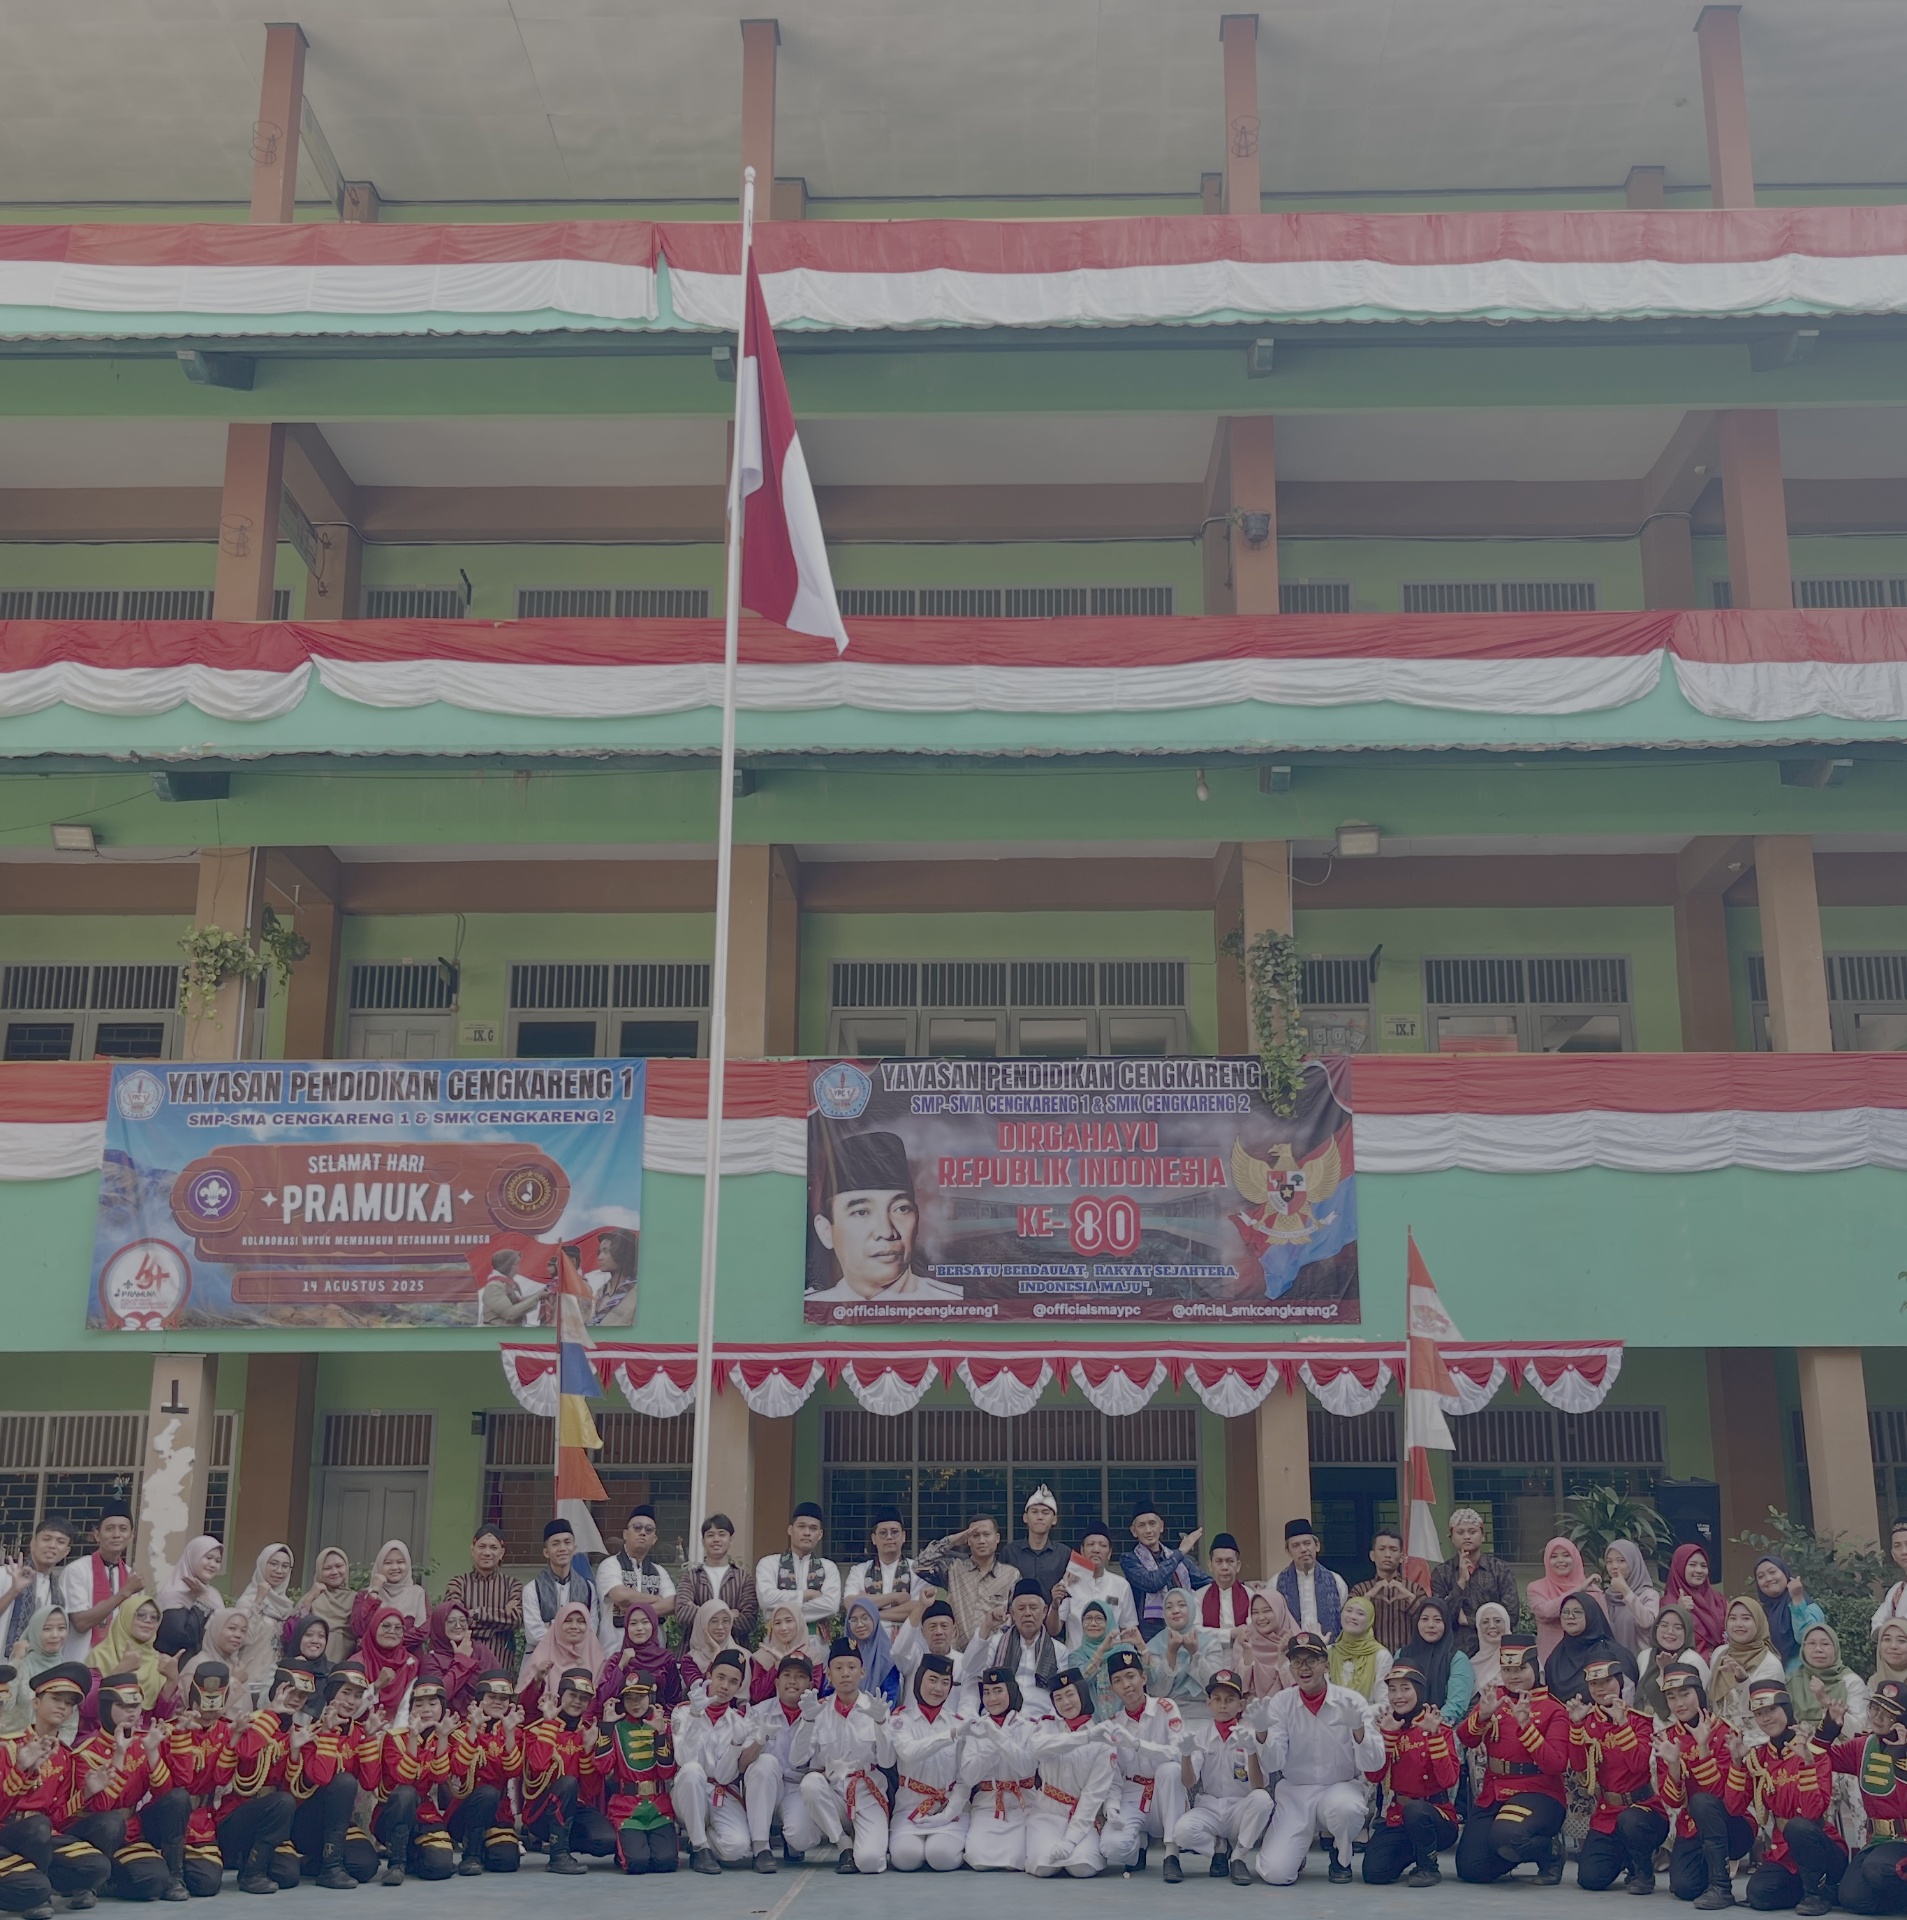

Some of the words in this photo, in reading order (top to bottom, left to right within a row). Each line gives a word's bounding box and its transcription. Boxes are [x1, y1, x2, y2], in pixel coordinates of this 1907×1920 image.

[880, 1062, 982, 1091] YAYASAN
[986, 1061, 1115, 1091] PENDIDIKAN
[1119, 1061, 1261, 1090] CENGKARENG
[168, 1071, 283, 1104] YAYASAN
[290, 1070, 440, 1103] PENDIDIKAN
[448, 1068, 614, 1102] CENGKARENG
[620, 1067, 634, 1099] 1
[911, 1094, 985, 1114] SMP-SMA
[986, 1094, 1079, 1114] CENGKARENG
[1081, 1094, 1090, 1113] 1
[1092, 1095, 1104, 1114] &
[1106, 1093, 1142, 1113] SMK
[1143, 1093, 1237, 1113] CENGKARENG
[1238, 1094, 1251, 1113] 2
[188, 1113, 267, 1127] SMP-SMA
[272, 1112, 395, 1126] CENGKARENG
[400, 1112, 410, 1125] 1
[415, 1112, 428, 1125] &
[433, 1111, 471, 1124] SMK
[477, 1111, 599, 1124] CENGKARENG
[604, 1110, 615, 1122] 2
[998, 1121, 1158, 1152] DIRGAHAYU
[308, 1153, 382, 1174] SELAMAT
[387, 1153, 425, 1174] HARI
[938, 1156, 1072, 1188] REPUBLIK
[1079, 1156, 1227, 1188] INDONESIA
[282, 1182, 454, 1225] PRAMUKA
[242, 1235, 299, 1246] KOLABORASI
[302, 1235, 331, 1246] UNTUK
[335, 1235, 394, 1246] MEMBANGUN
[397, 1235, 450, 1245] KETAHANAN
[454, 1234, 490, 1245] BANGSA
[1001, 1264, 1089, 1278] BERDAULAT,
[1094, 1264, 1152, 1277] RAKYAT
[1154, 1264, 1240, 1279] SEJAHTERA,
[303, 1280, 318, 1292] 14
[324, 1280, 386, 1292] AGUSTUS
[393, 1280, 425, 1292] 2025
[1019, 1280, 1100, 1294] INDONESIA
[833, 1303, 999, 1320] @officialsmpcengkareng1
[1033, 1303, 1141, 1318] @officialsmaypc
[1172, 1303, 1339, 1319] @official_smkcengkareng2
